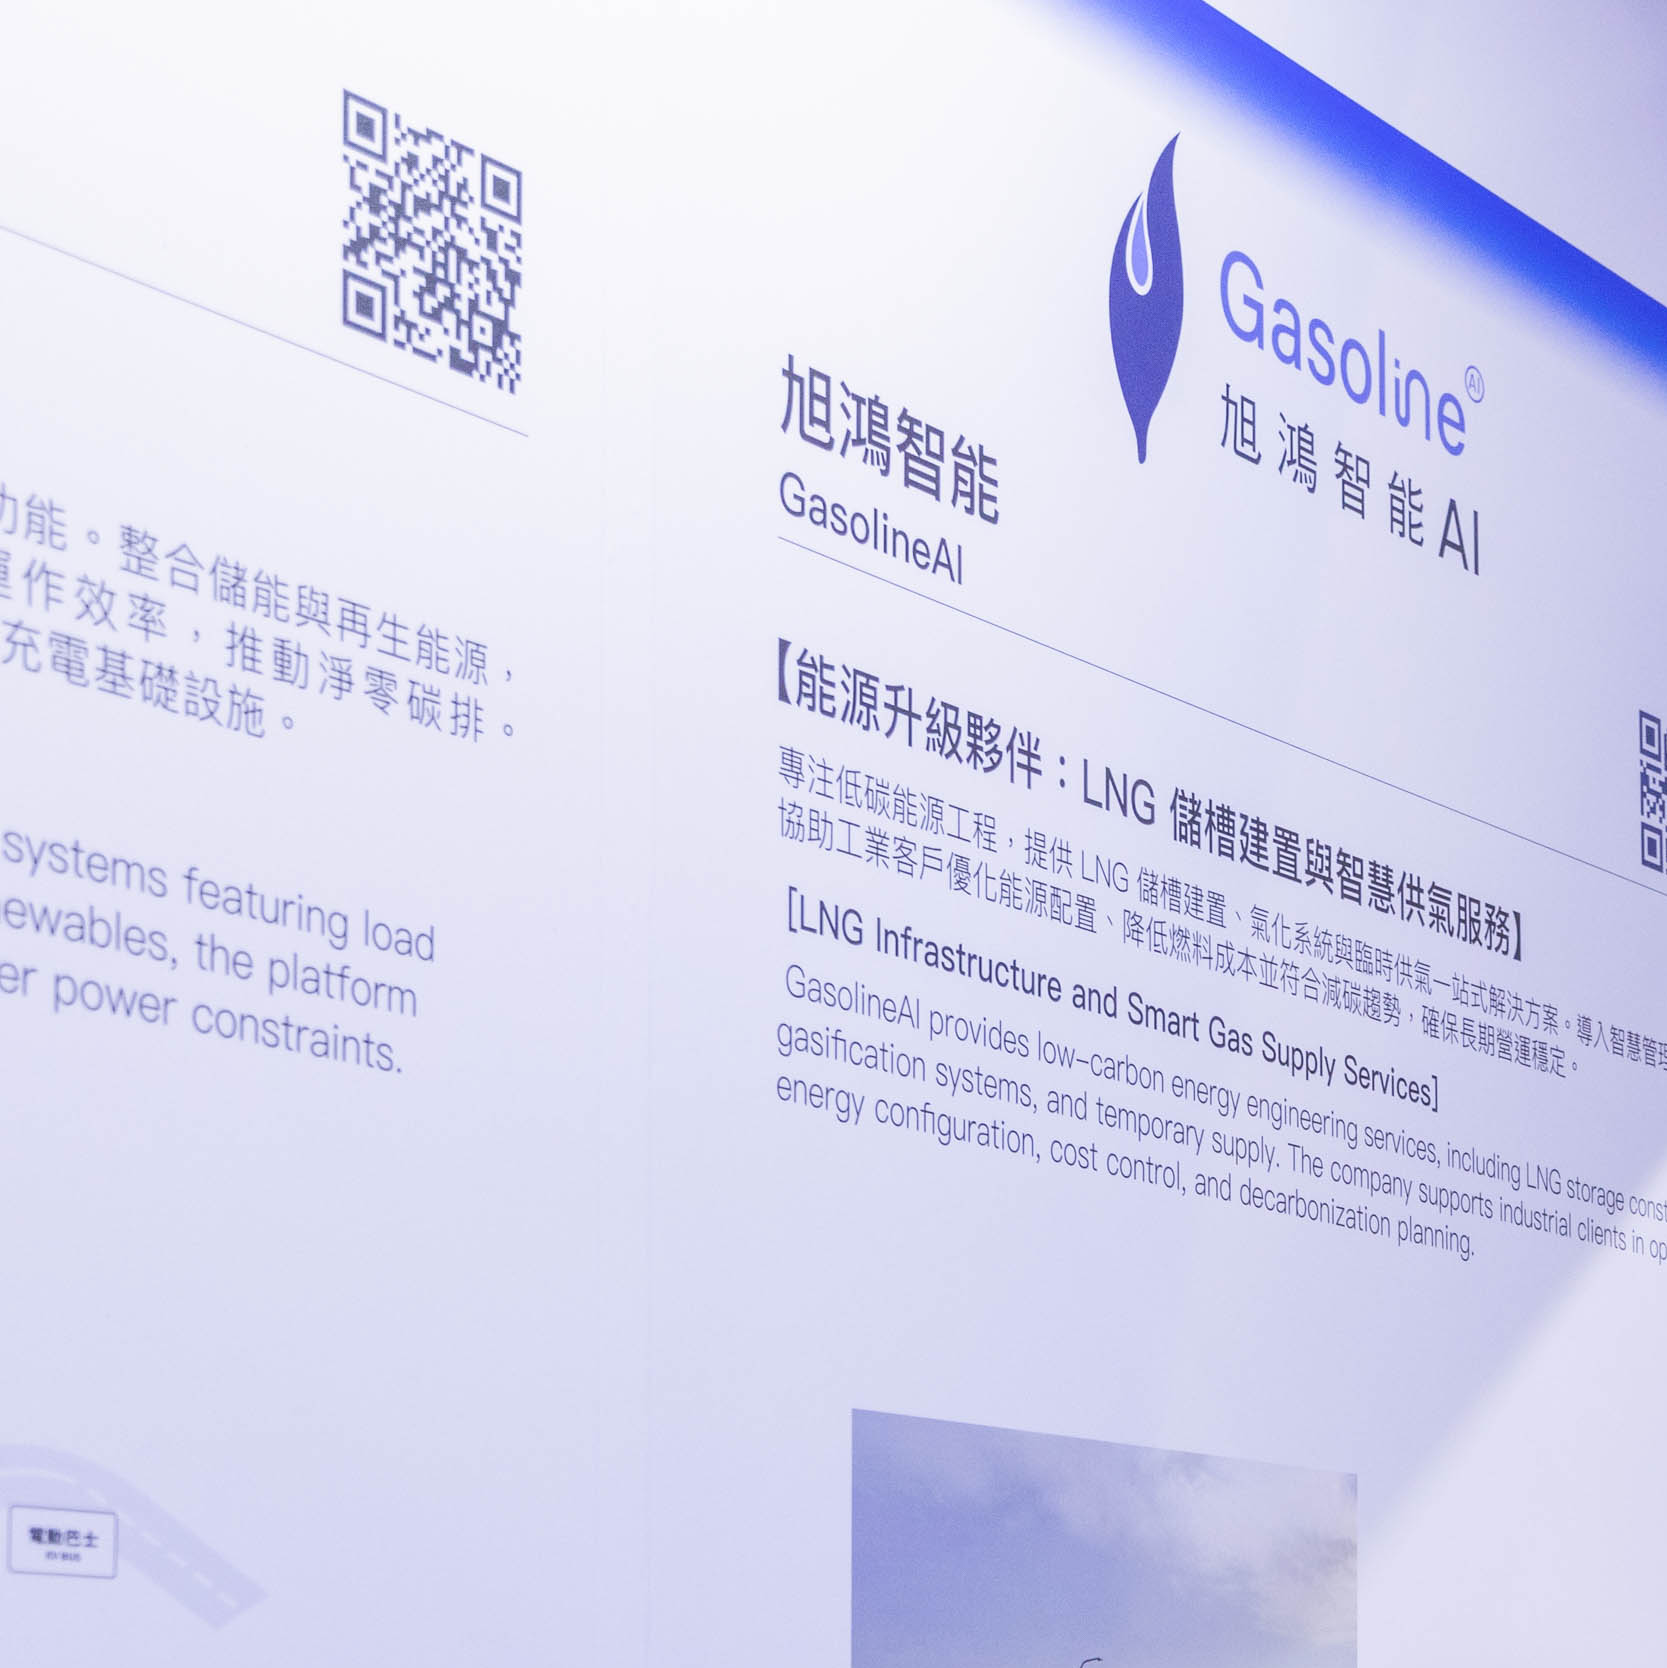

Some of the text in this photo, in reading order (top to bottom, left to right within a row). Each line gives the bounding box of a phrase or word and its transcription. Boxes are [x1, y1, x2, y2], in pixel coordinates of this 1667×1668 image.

[779, 354, 1000, 525] 旭鴻智能
[1218, 250, 1467, 458] Gasoline
[778, 472, 964, 586] GasolineAI
[2, 619, 295, 739] 充電基礎設施。
[3, 831, 436, 962] systems featuring load
[777, 745, 1073, 879] 專注低碳能源工程，提供
[1080, 849, 1129, 893] LNG
[1170, 786, 1522, 962] 儲槽建置與智慧供氣服務】
[53, 973, 179, 1026] power
[191, 1000, 404, 1074] constraints.
[195, 932, 255, 982] the
[268, 952, 418, 1017] platform
[787, 886, 1439, 1113] [LNG Infrastructure and Smart Gas Supply Services]
[776, 1021, 927, 1083] gasification
[935, 1061, 1038, 1113] systems,
[1046, 1087, 1088, 1121] and
[1095, 1096, 1205, 1156] temporary
[1211, 1127, 1280, 1173] supply.
[1287, 1142, 1324, 1179] The
[1330, 1160, 1412, 1206] company
[1418, 1181, 1494, 1221] supports
[1498, 1198, 1572, 1239] industrial
[1577, 1215, 1627, 1253] clients
[1631, 1229, 1645, 1257] in
[776, 1075, 1475, 1263] energy configuration, cost control, and decarbonization planning.
[785, 963, 921, 1030] GasolineAI
[929, 1004, 1030, 1059] provides
[1170, 1072, 1241, 1119] energy
[1246, 1093, 1358, 1149] engineering
[1363, 1125, 1442, 1169] services,
[1446, 1140, 1522, 1192] including
[1525, 1162, 1563, 1197] LNG
[1566, 1178, 1625, 1214] storage
